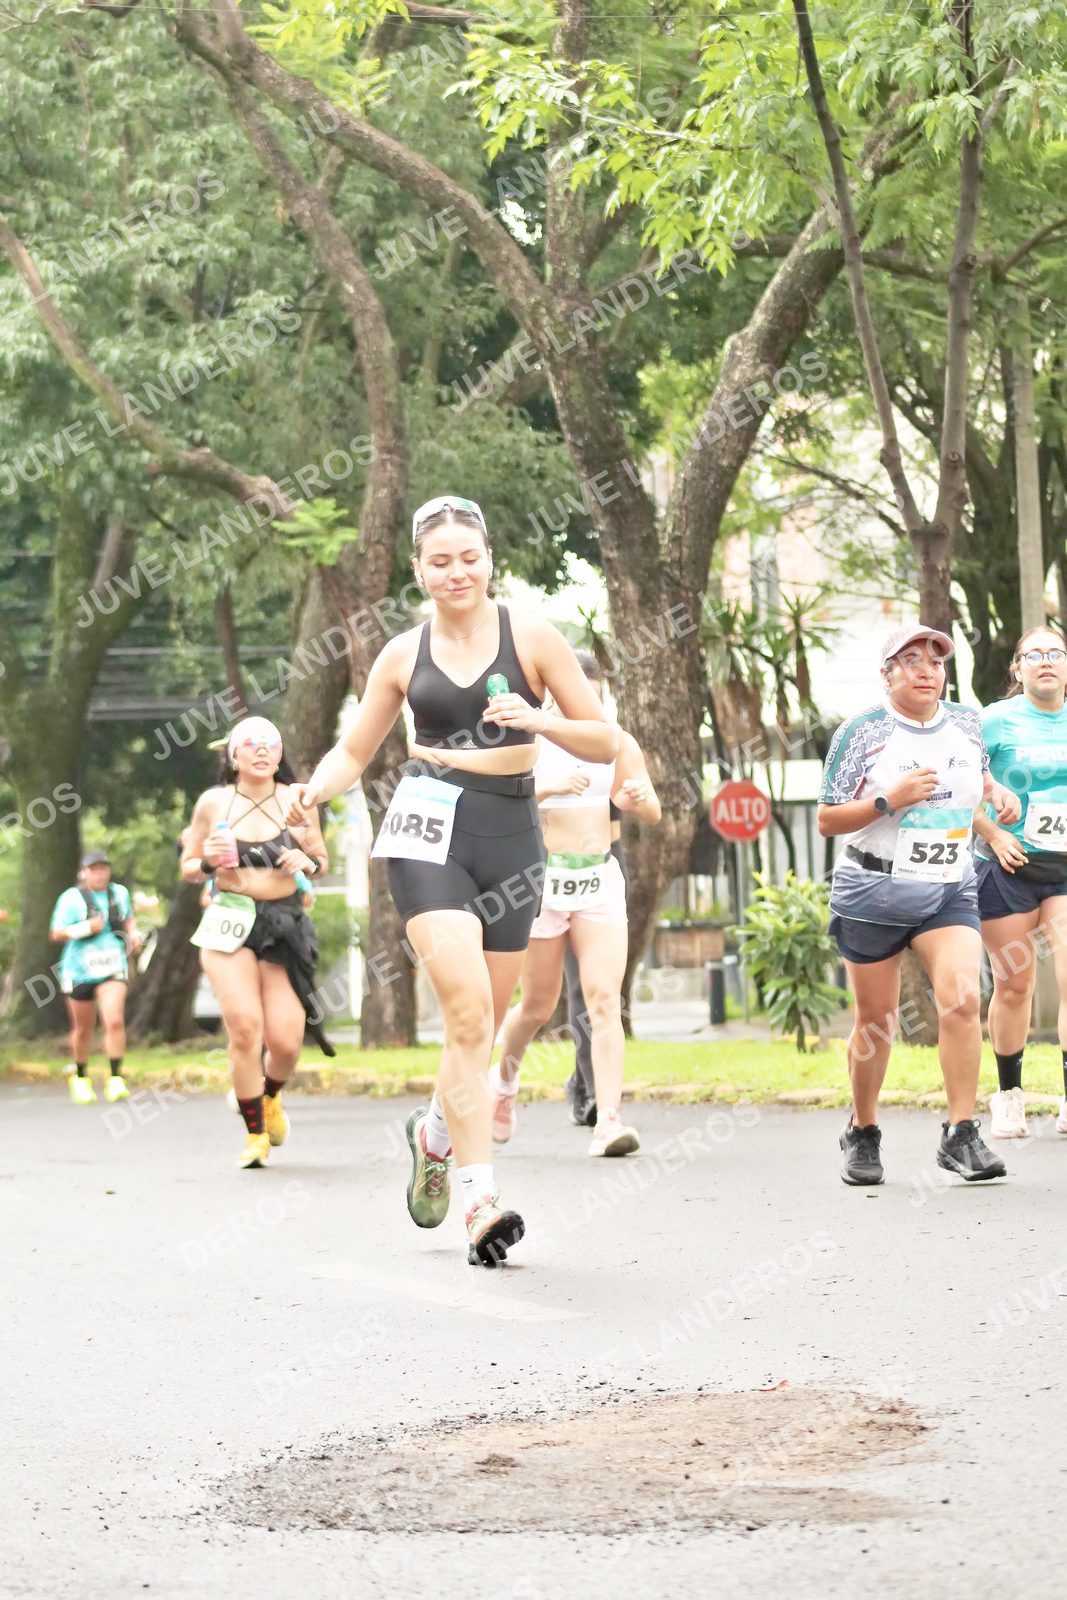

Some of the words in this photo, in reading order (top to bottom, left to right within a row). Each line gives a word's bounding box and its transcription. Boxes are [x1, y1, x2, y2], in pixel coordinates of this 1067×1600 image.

[717, 797, 766, 823] ALTO
[1037, 816, 1067, 835] 24
[909, 842, 959, 865] 523
[551, 877, 601, 895] 1979
